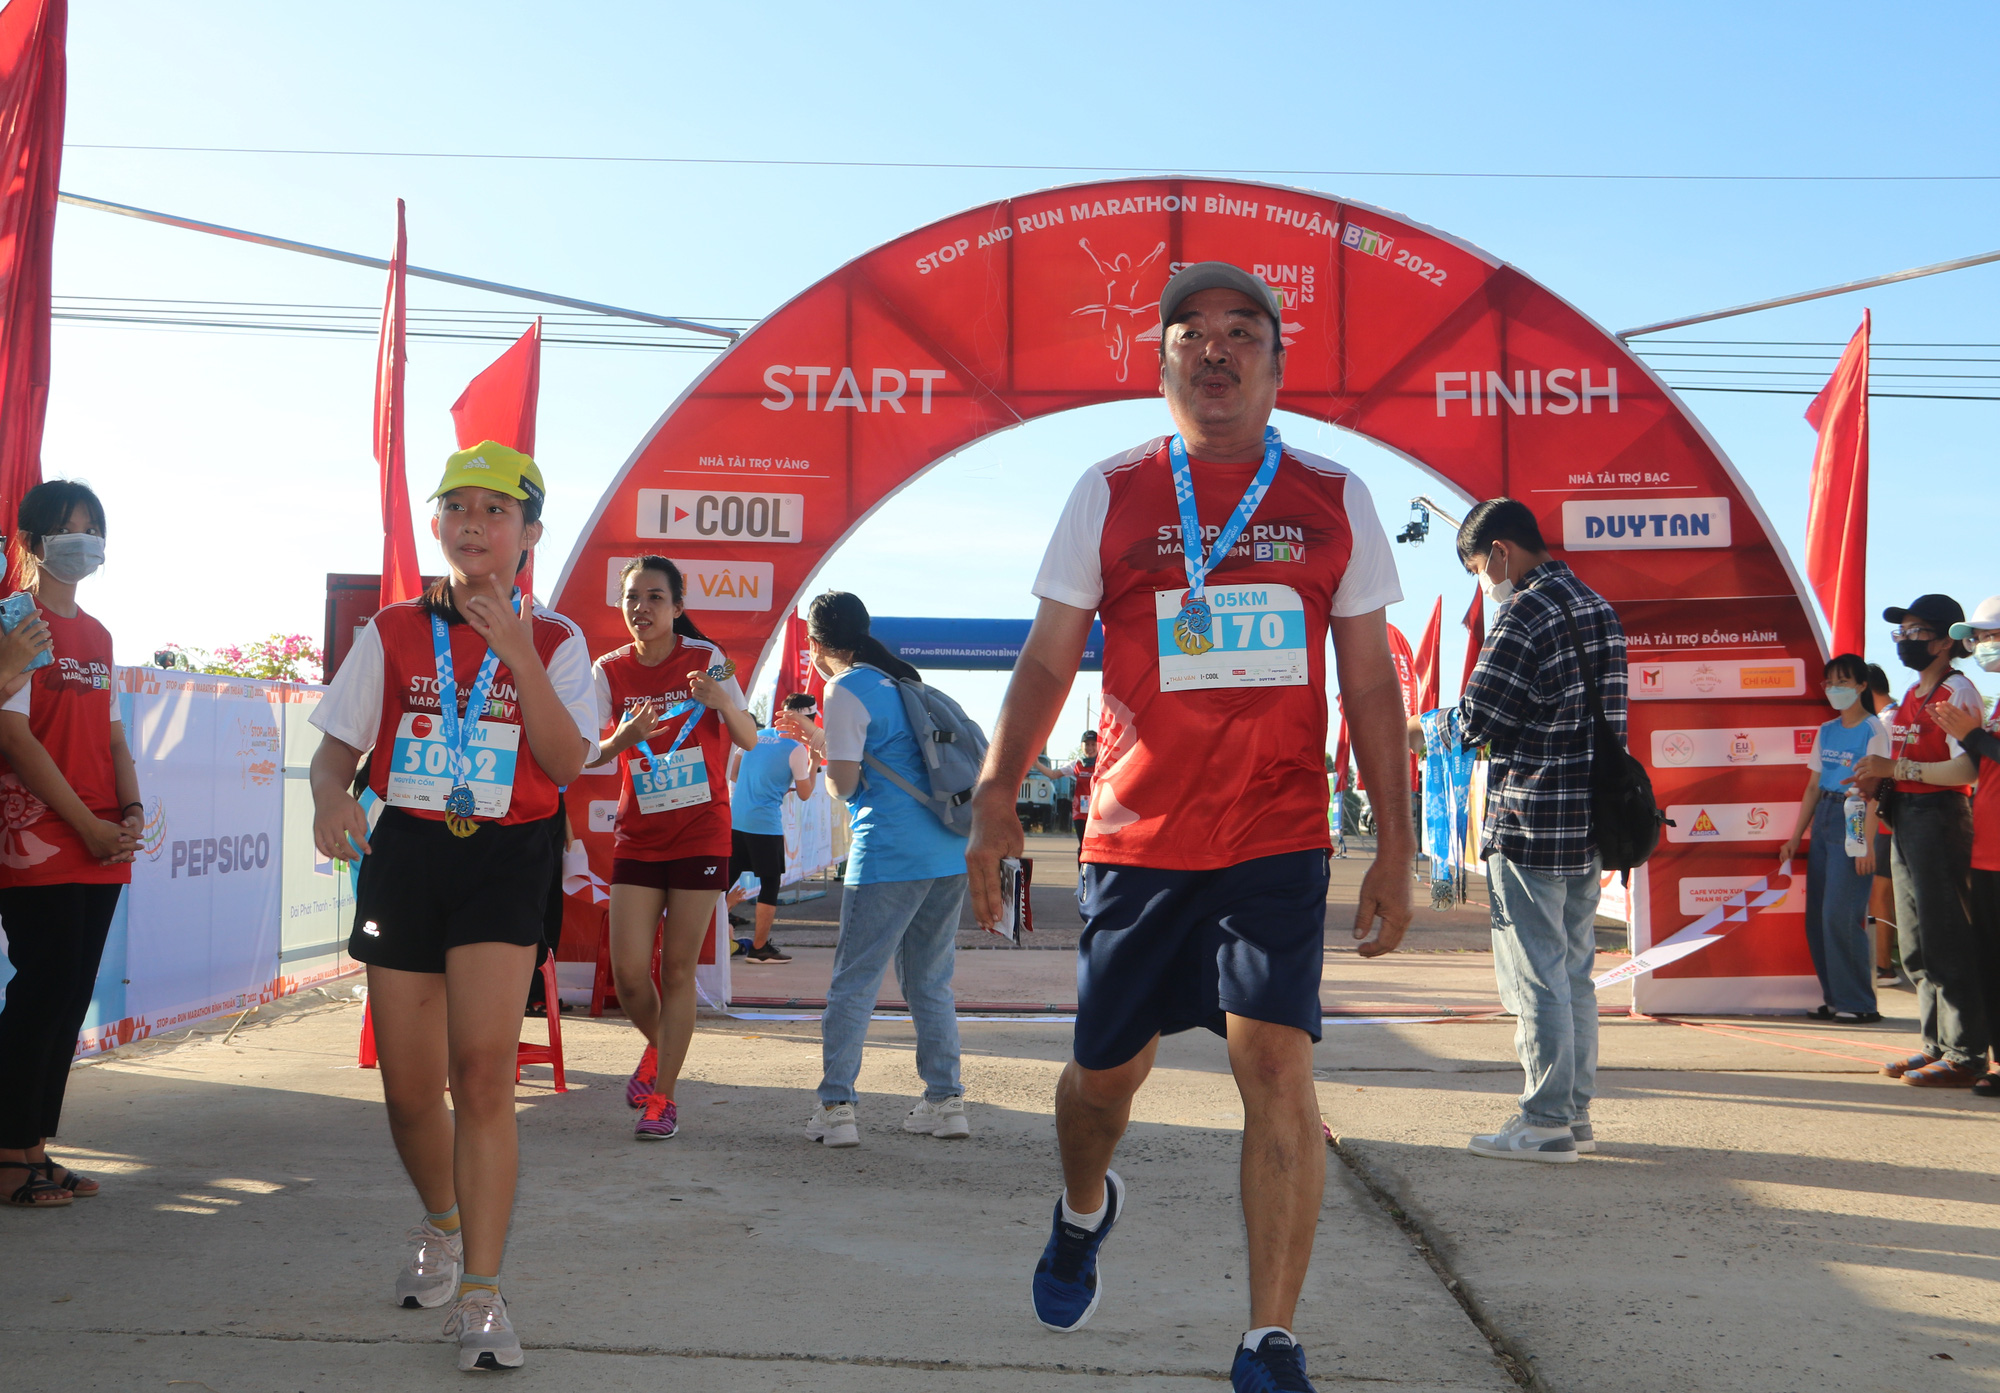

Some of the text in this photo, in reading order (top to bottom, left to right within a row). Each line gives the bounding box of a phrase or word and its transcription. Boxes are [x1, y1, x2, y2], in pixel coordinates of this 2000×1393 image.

[915, 193, 1448, 287] STOP AND RUN MARATHON BÌNH THUẬN BTV 2022
[1253, 264, 1297, 283] RUN
[1301, 265, 1314, 303] 2022
[761, 364, 946, 414] START
[1435, 367, 1618, 417] FINISH
[699, 455, 810, 471] NHÀ TÀI TRỢ VÀNG
[1568, 472, 1670, 486] NHÀ TÀI TRỢ BẠC
[695, 495, 790, 538] COOL
[1585, 513, 1710, 539] DUYTAN
[1253, 525, 1303, 541] RUN
[1255, 543, 1305, 562] BTV
[698, 569, 759, 598] VÂN
[1214, 592, 1268, 607] 05KM
[1211, 613, 1285, 649] 170
[1626, 629, 1777, 647] NHÀ TÀI TRỢ ĐỒNG HÀNH
[900, 647, 921, 655] STOP
[934, 648, 951, 656] RUN
[952, 648, 999, 657] MARATHON
[999, 647, 1018, 657] BÌNH
[665, 690, 687, 701] RUN
[171, 832, 270, 879] PEPSICO
[157, 1017, 168, 1028] STOP
[178, 1013, 186, 1022] RUN
[188, 1006, 211, 1020] MARATHON
